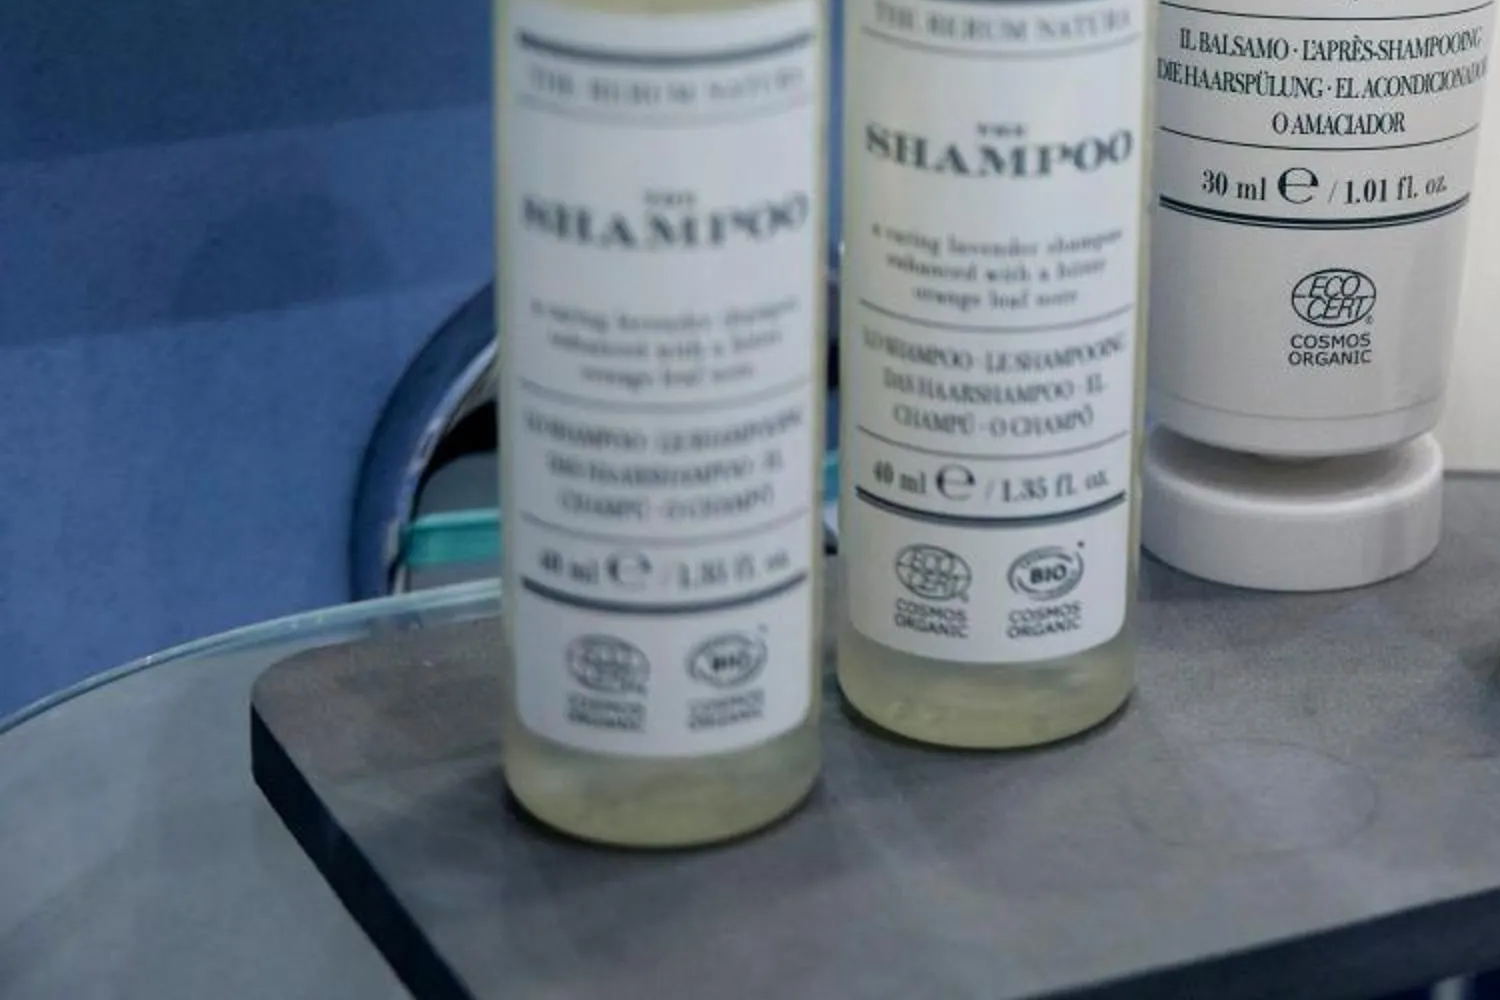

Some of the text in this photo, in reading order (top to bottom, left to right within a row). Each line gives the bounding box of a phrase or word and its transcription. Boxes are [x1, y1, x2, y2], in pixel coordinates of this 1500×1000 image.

[1180, 27, 1197, 50] IL
[1199, 30, 1289, 60] BALSAMO
[1157, 57, 1184, 84] DIE
[1185, 64, 1324, 99] HAARSPÜLUNG
[1335, 77, 1360, 99] EL
[1272, 112, 1406, 136] O AMACIADOR
[865, 122, 1134, 178] SHAMPOO
[1201, 169, 1228, 197] 30
[1236, 176, 1266, 202] ml
[1345, 178, 1389, 204] 1.01
[1397, 175, 1418, 201] fl.
[1308, 274, 1362, 298] ECO
[1305, 296, 1367, 321] CERT
[1289, 331, 1371, 350] COSMOS
[1287, 349, 1372, 367] ORGANIC
[899, 471, 927, 495] ml
[1030, 564, 1068, 585] BIO
